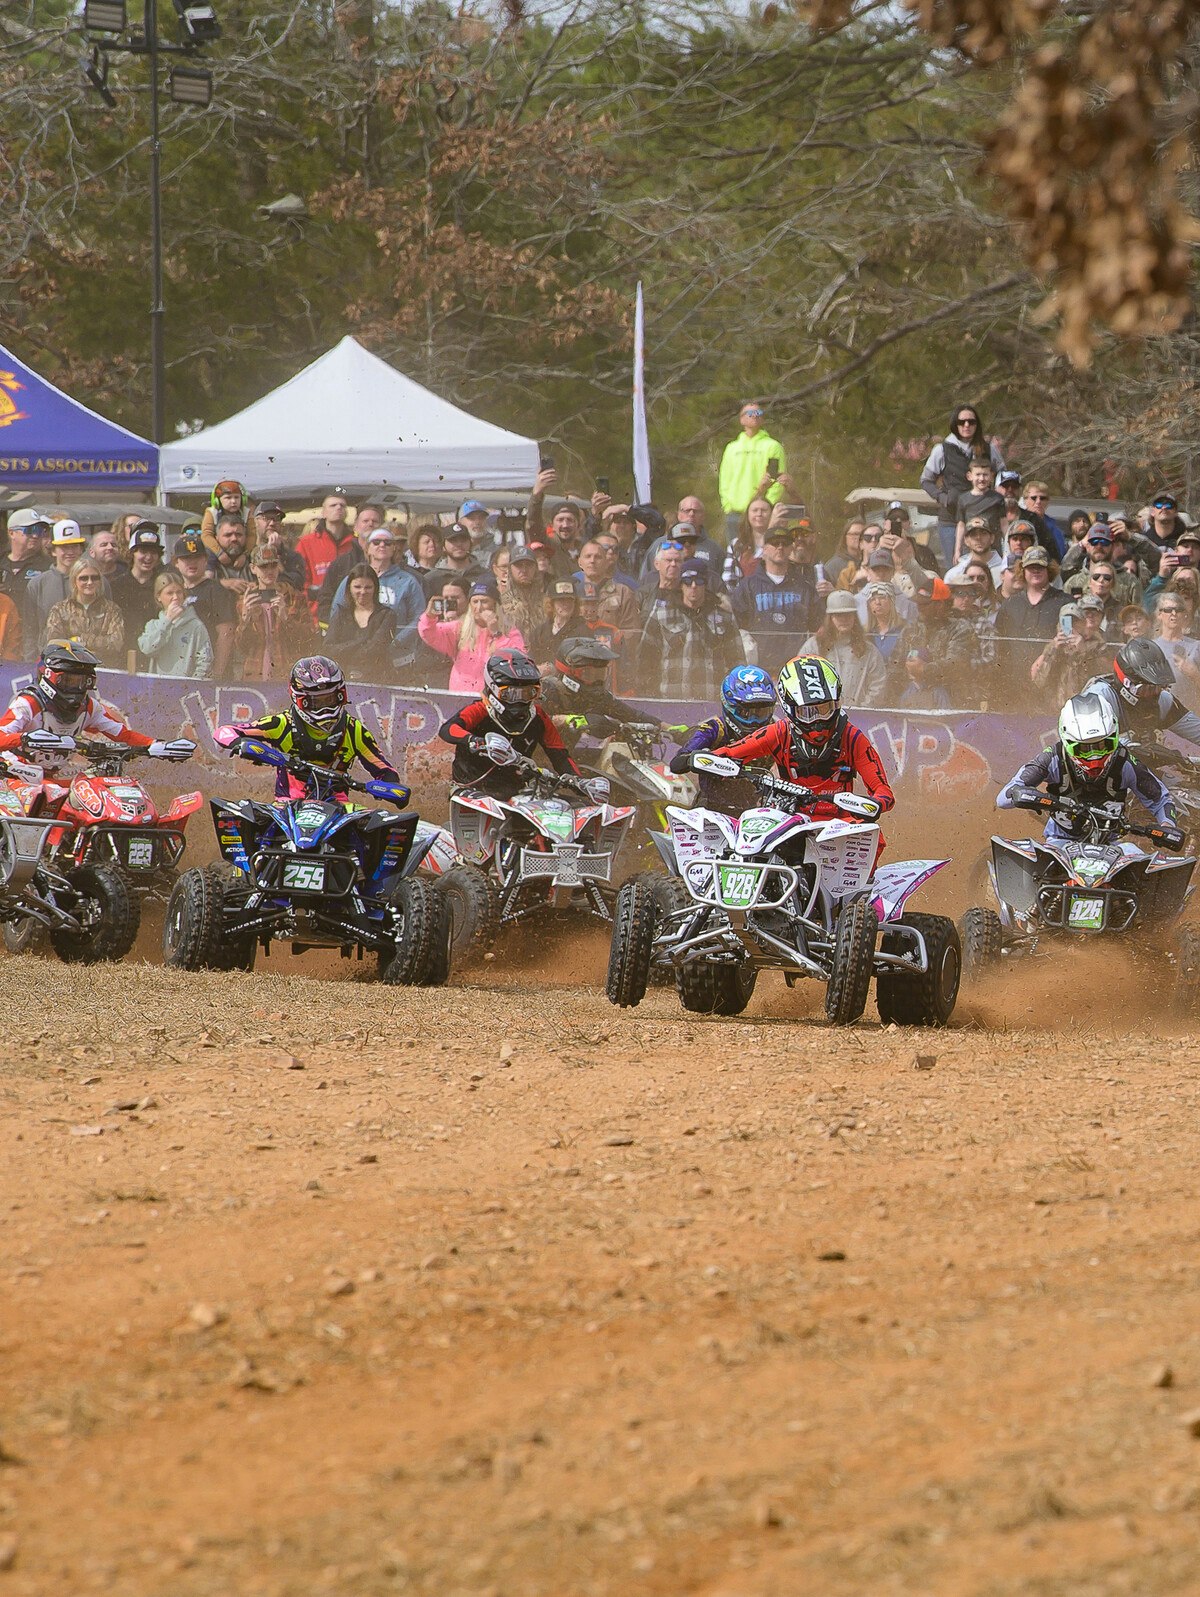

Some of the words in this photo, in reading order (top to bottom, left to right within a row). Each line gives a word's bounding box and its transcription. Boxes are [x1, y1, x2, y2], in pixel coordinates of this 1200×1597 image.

[33, 458, 149, 475] ASSOCIATION
[801, 664, 827, 700] FXR
[295, 810, 328, 825] 259
[282, 864, 325, 891] 259
[723, 871, 755, 900] 928
[1068, 899, 1104, 922] 926
